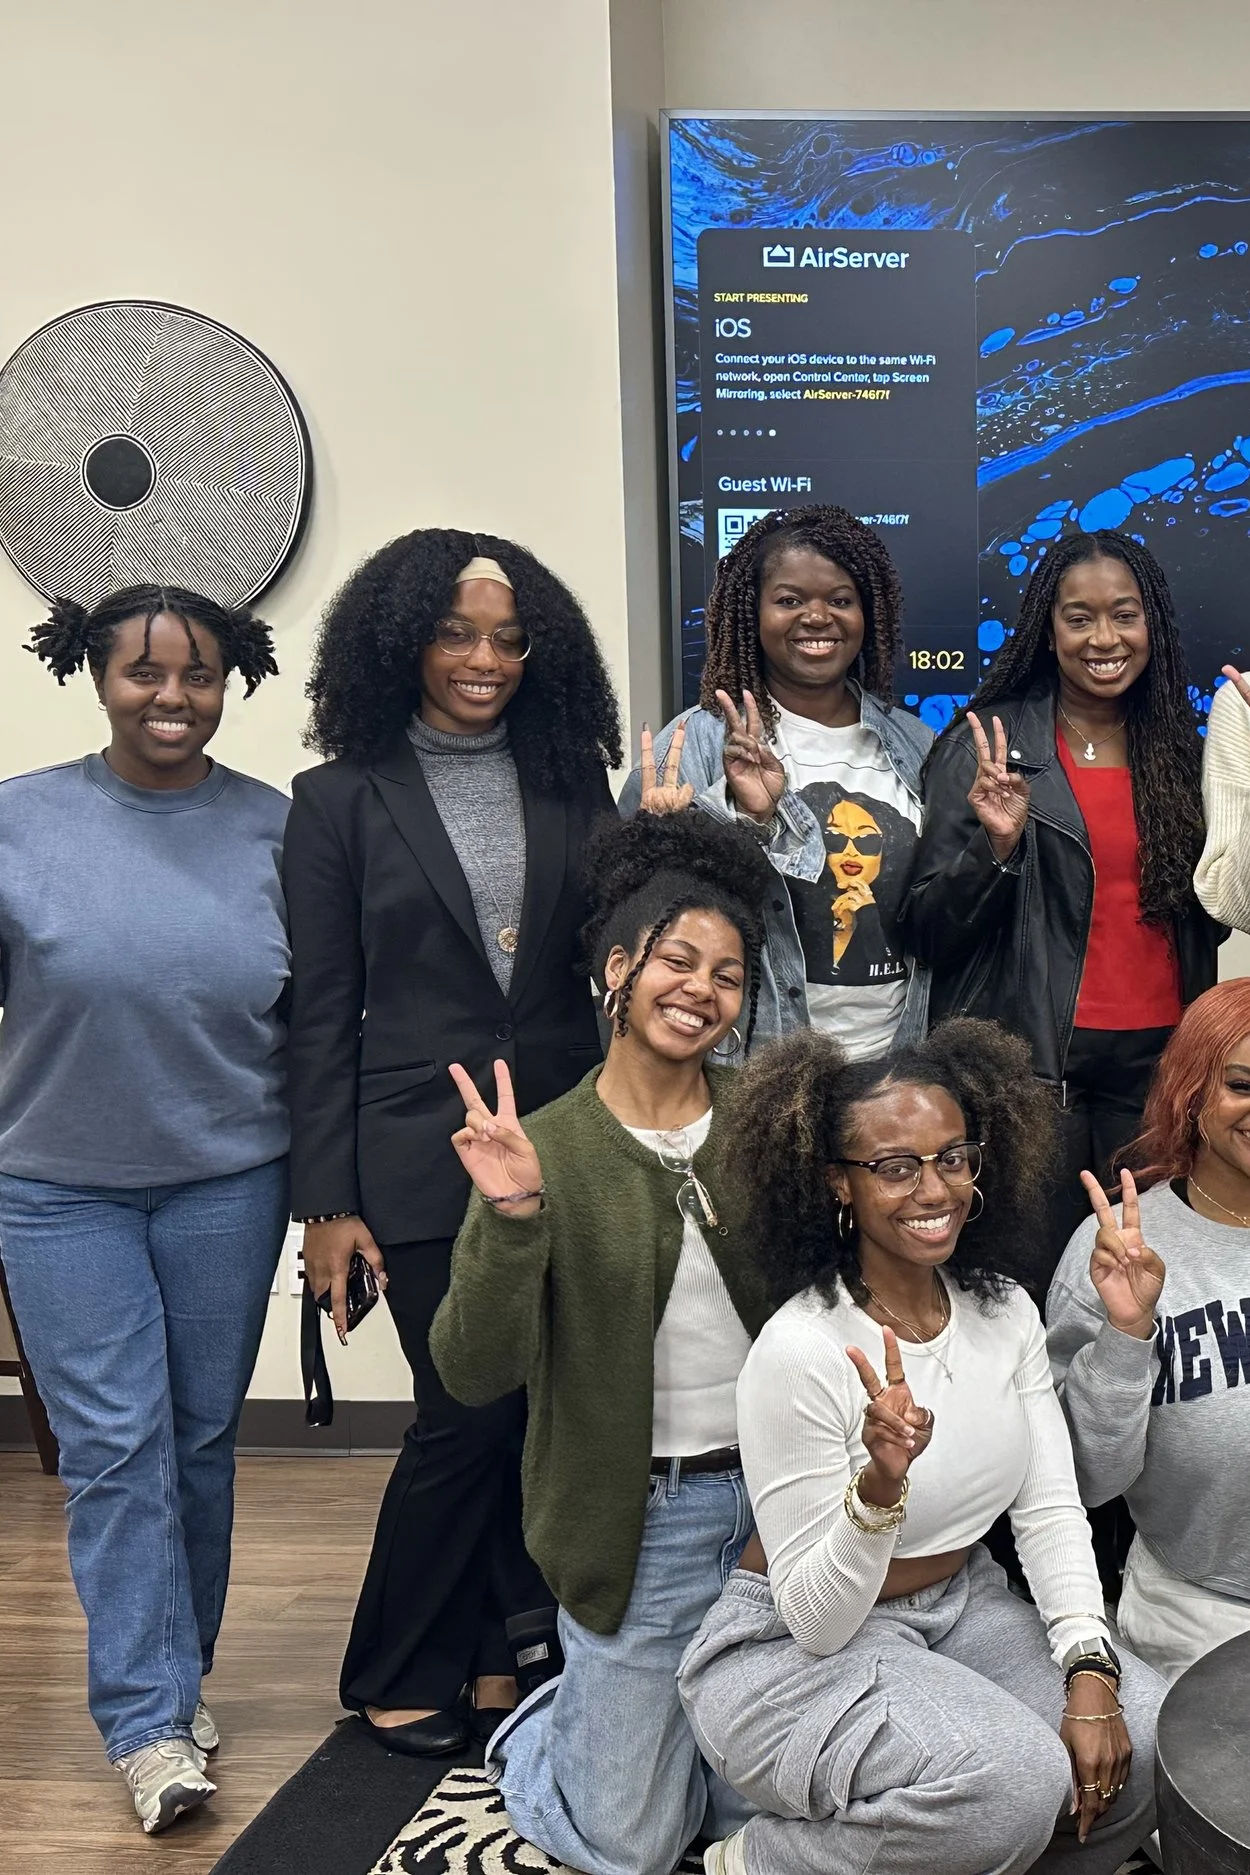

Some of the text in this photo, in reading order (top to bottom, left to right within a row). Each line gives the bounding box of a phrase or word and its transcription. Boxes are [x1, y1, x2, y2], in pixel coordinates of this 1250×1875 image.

[799, 246, 910, 268] AirServer
[713, 293, 809, 303] START PRESENTING
[715, 317, 752, 338] iOS
[715, 353, 936, 366] Connect your iOS device to the same Wi-Fi
[716, 371, 930, 384] network, open Control Center, tap Screen
[716, 388, 768, 401] Mirroring,
[769, 389, 801, 400] select
[718, 476, 812, 492] Guest Wi-Fi
[909, 650, 965, 670] 18:02
